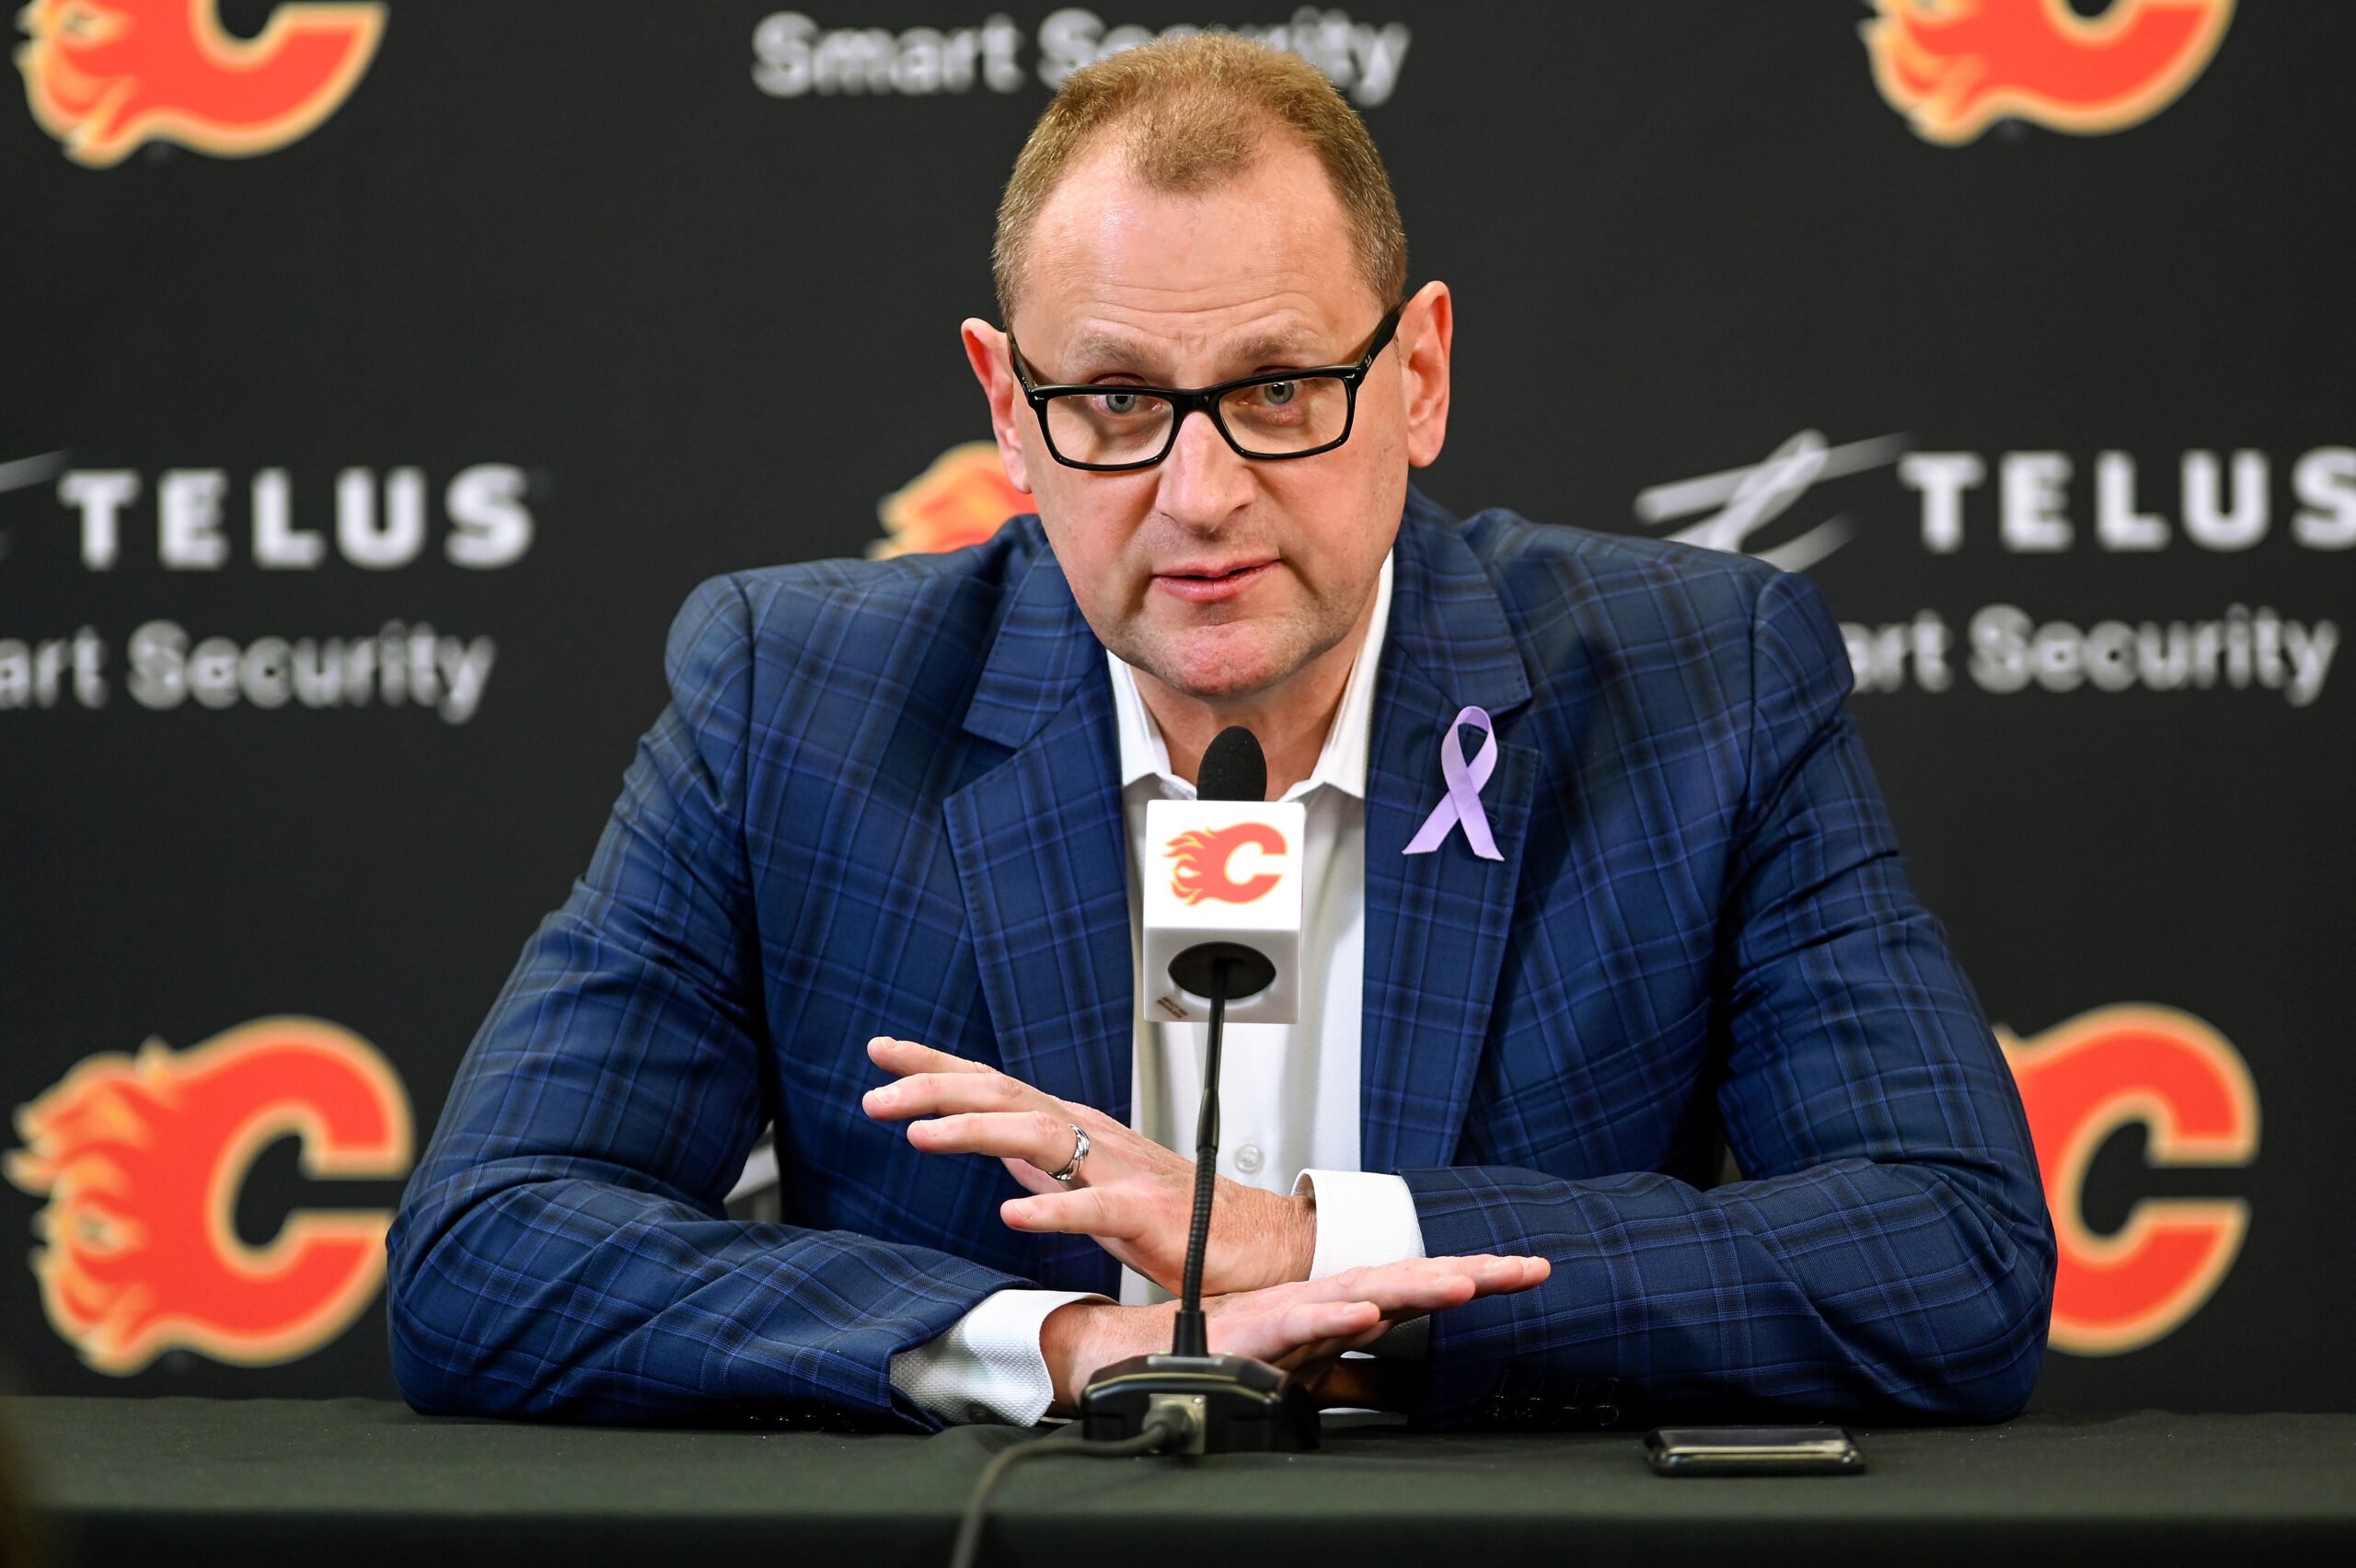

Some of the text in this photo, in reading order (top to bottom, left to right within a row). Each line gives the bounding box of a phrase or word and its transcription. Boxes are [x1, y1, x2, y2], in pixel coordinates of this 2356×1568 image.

[752, 10, 1023, 98] Smart
[57, 462, 534, 571] TELUS
[1899, 445, 2356, 552] TELUS
[127, 619, 495, 723] Security
[1968, 604, 2339, 706] Security
